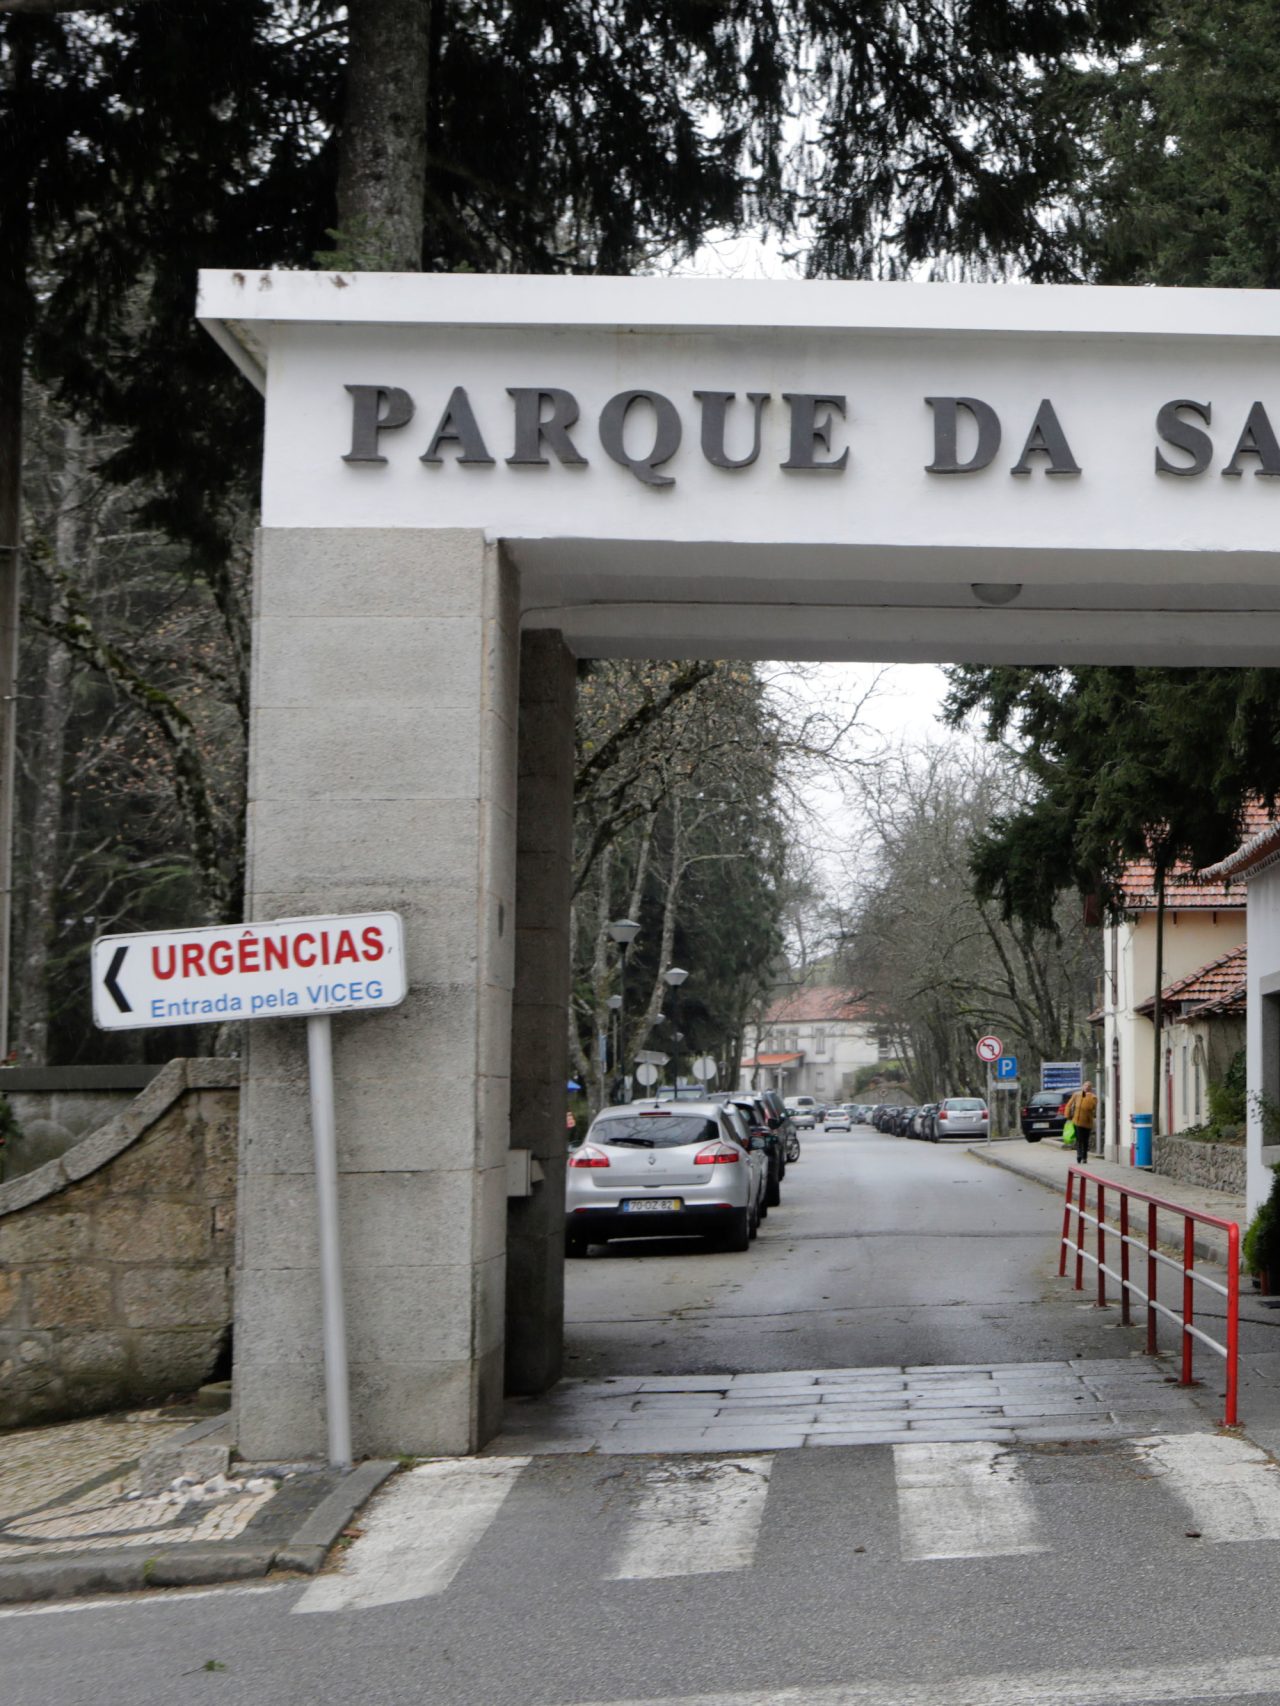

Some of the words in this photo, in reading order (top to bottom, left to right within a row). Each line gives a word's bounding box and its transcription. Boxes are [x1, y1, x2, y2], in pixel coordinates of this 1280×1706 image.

[341, 384, 851, 487] PARQUE
[924, 396, 1083, 475] DA
[151, 926, 384, 981] URGÊNCIAS
[151, 993, 243, 1019] Entrada
[250, 988, 299, 1014] pela
[307, 980, 384, 1005] VICEG
[1002, 1060, 1012, 1075] P
